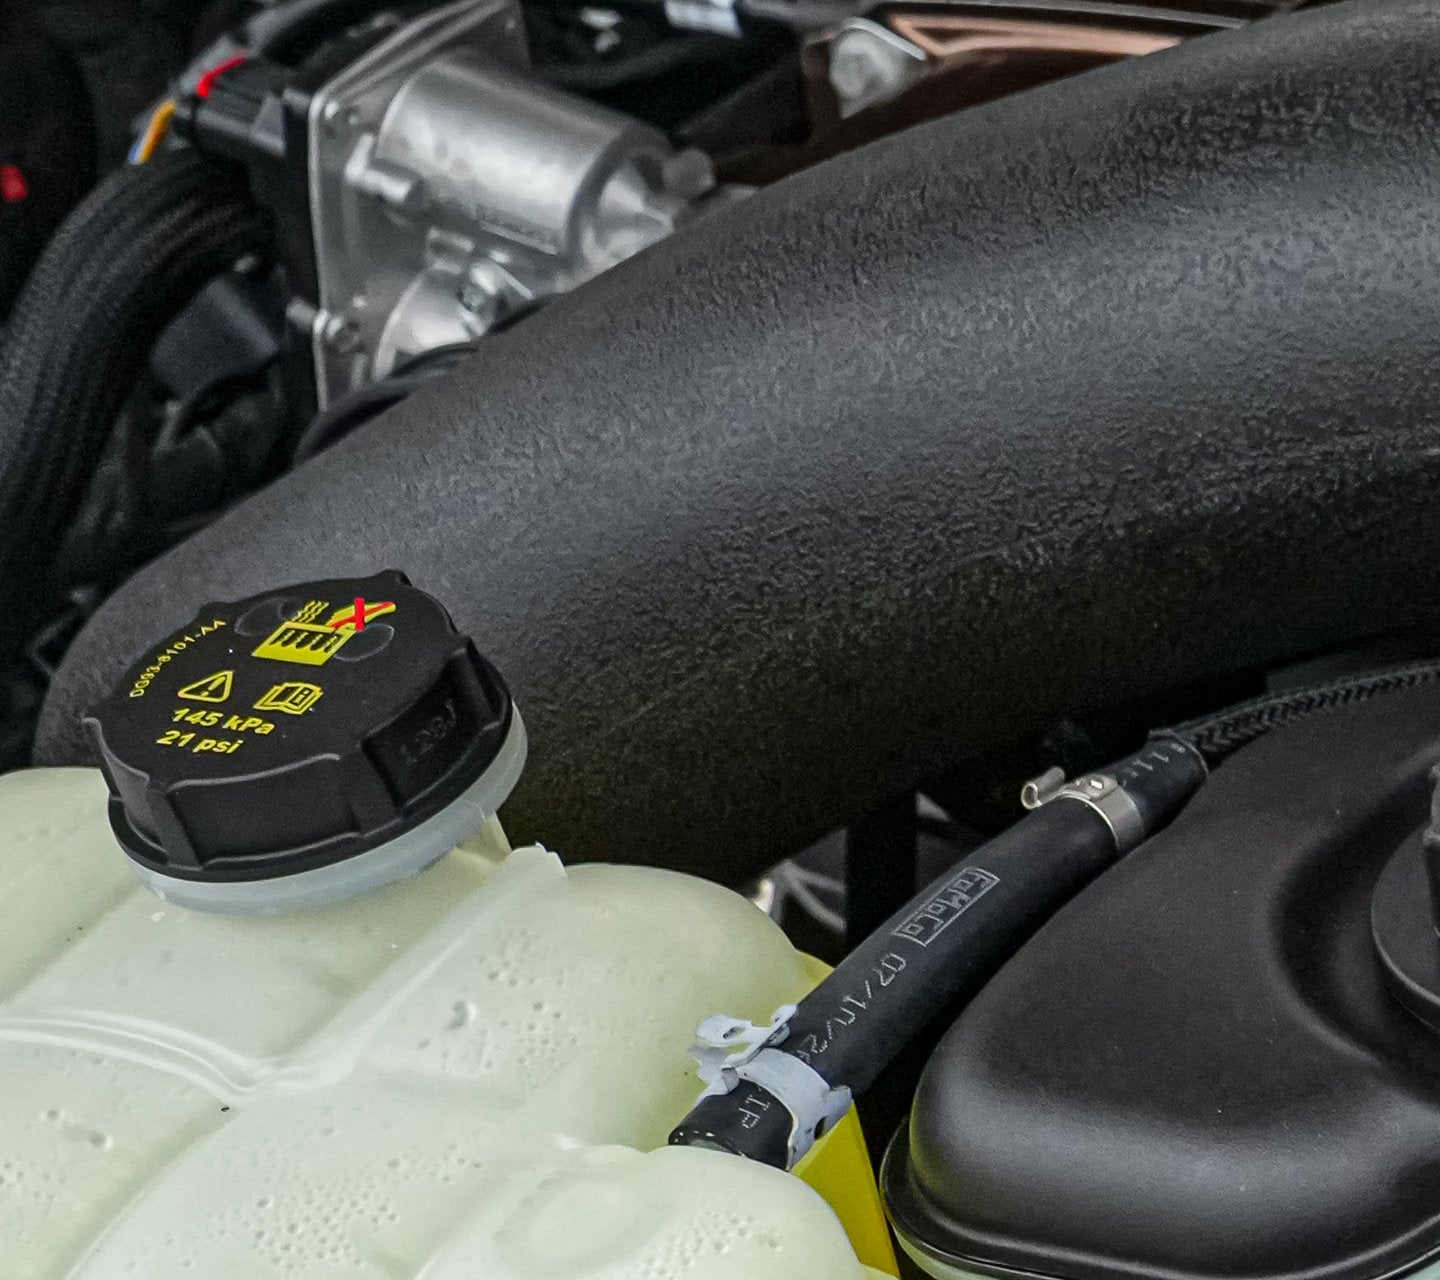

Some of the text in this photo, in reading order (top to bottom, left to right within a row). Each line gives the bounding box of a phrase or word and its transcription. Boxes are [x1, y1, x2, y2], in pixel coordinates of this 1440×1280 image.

[172, 707, 276, 735] 145 kPa
[156, 729, 244, 754] 21 psi
